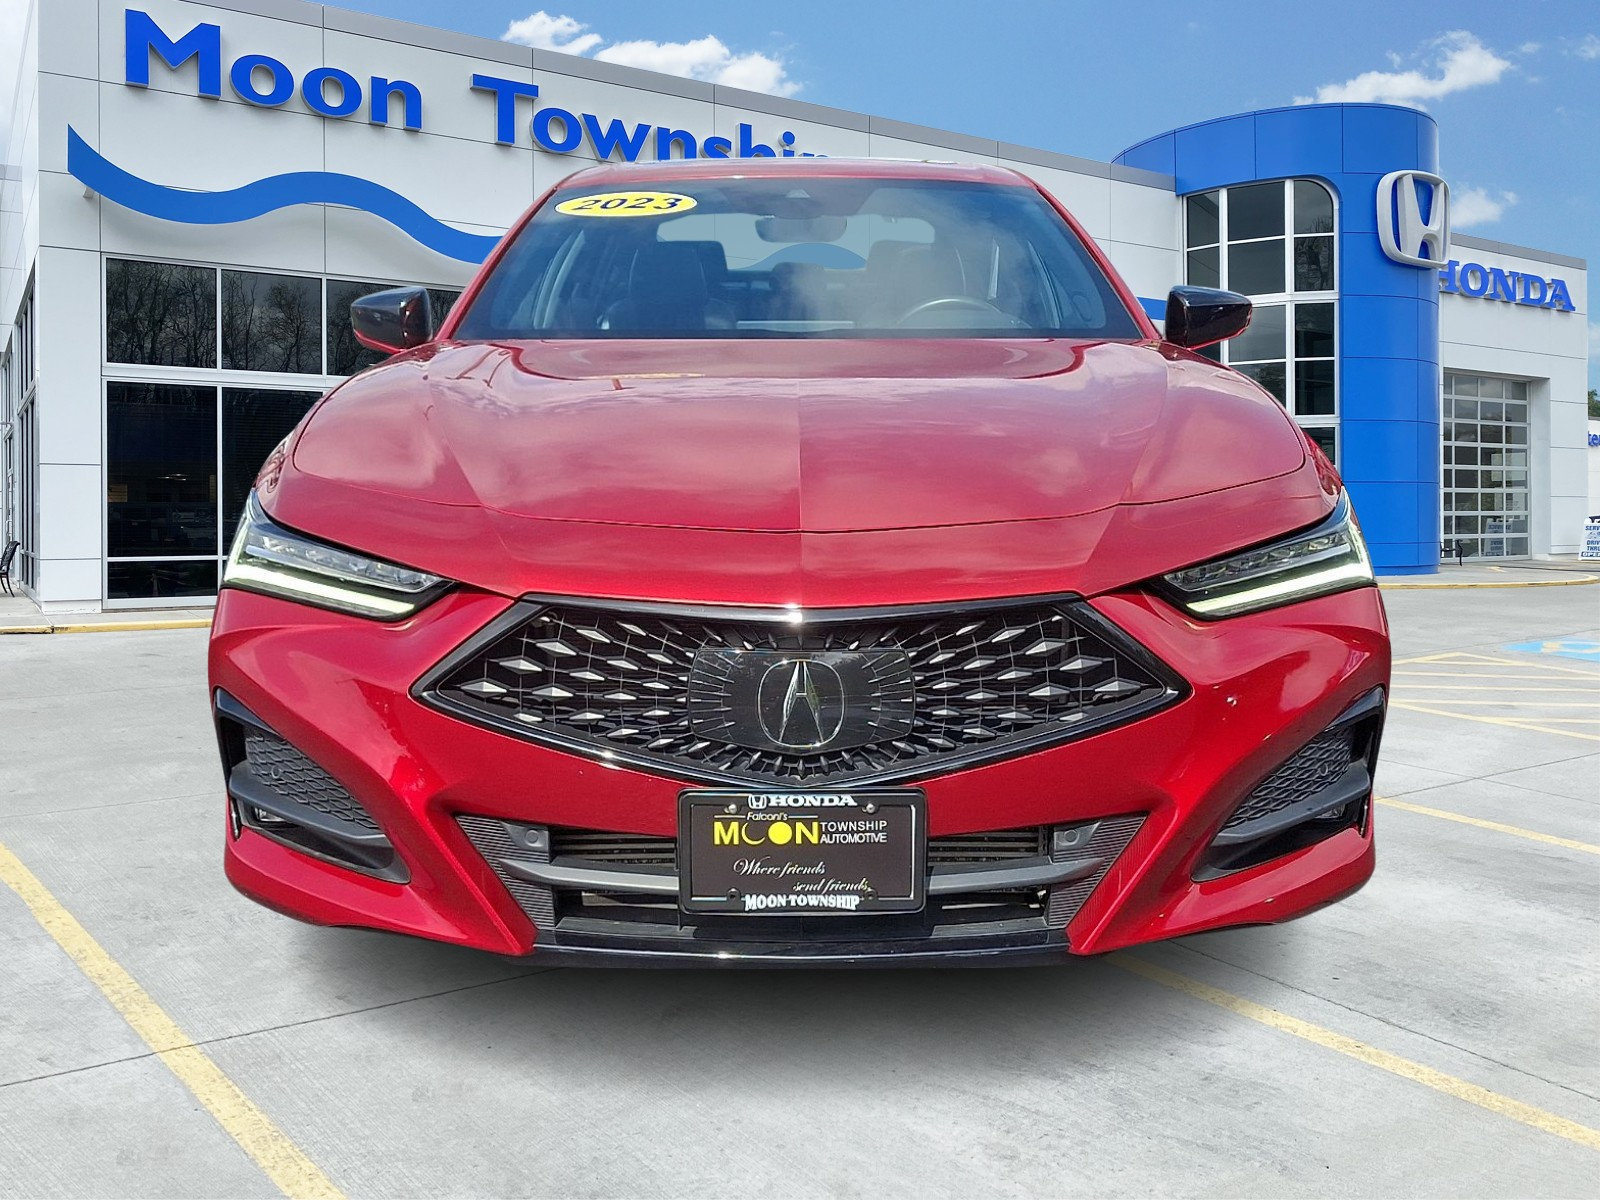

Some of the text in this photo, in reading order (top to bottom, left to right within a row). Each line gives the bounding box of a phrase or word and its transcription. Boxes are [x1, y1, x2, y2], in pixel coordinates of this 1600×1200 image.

[125, 8, 828, 163] Moon Townshi
[571, 197, 682, 211] 2023
[768, 795, 858, 807] HONDA
[820, 820, 888, 831] TOWNSHIP
[820, 832, 887, 844] AUTOMOTIVE
[733, 856, 826, 880] Where friends
[793, 878, 825, 892] send
[744, 894, 861, 912] MOON TOWNSHIP
